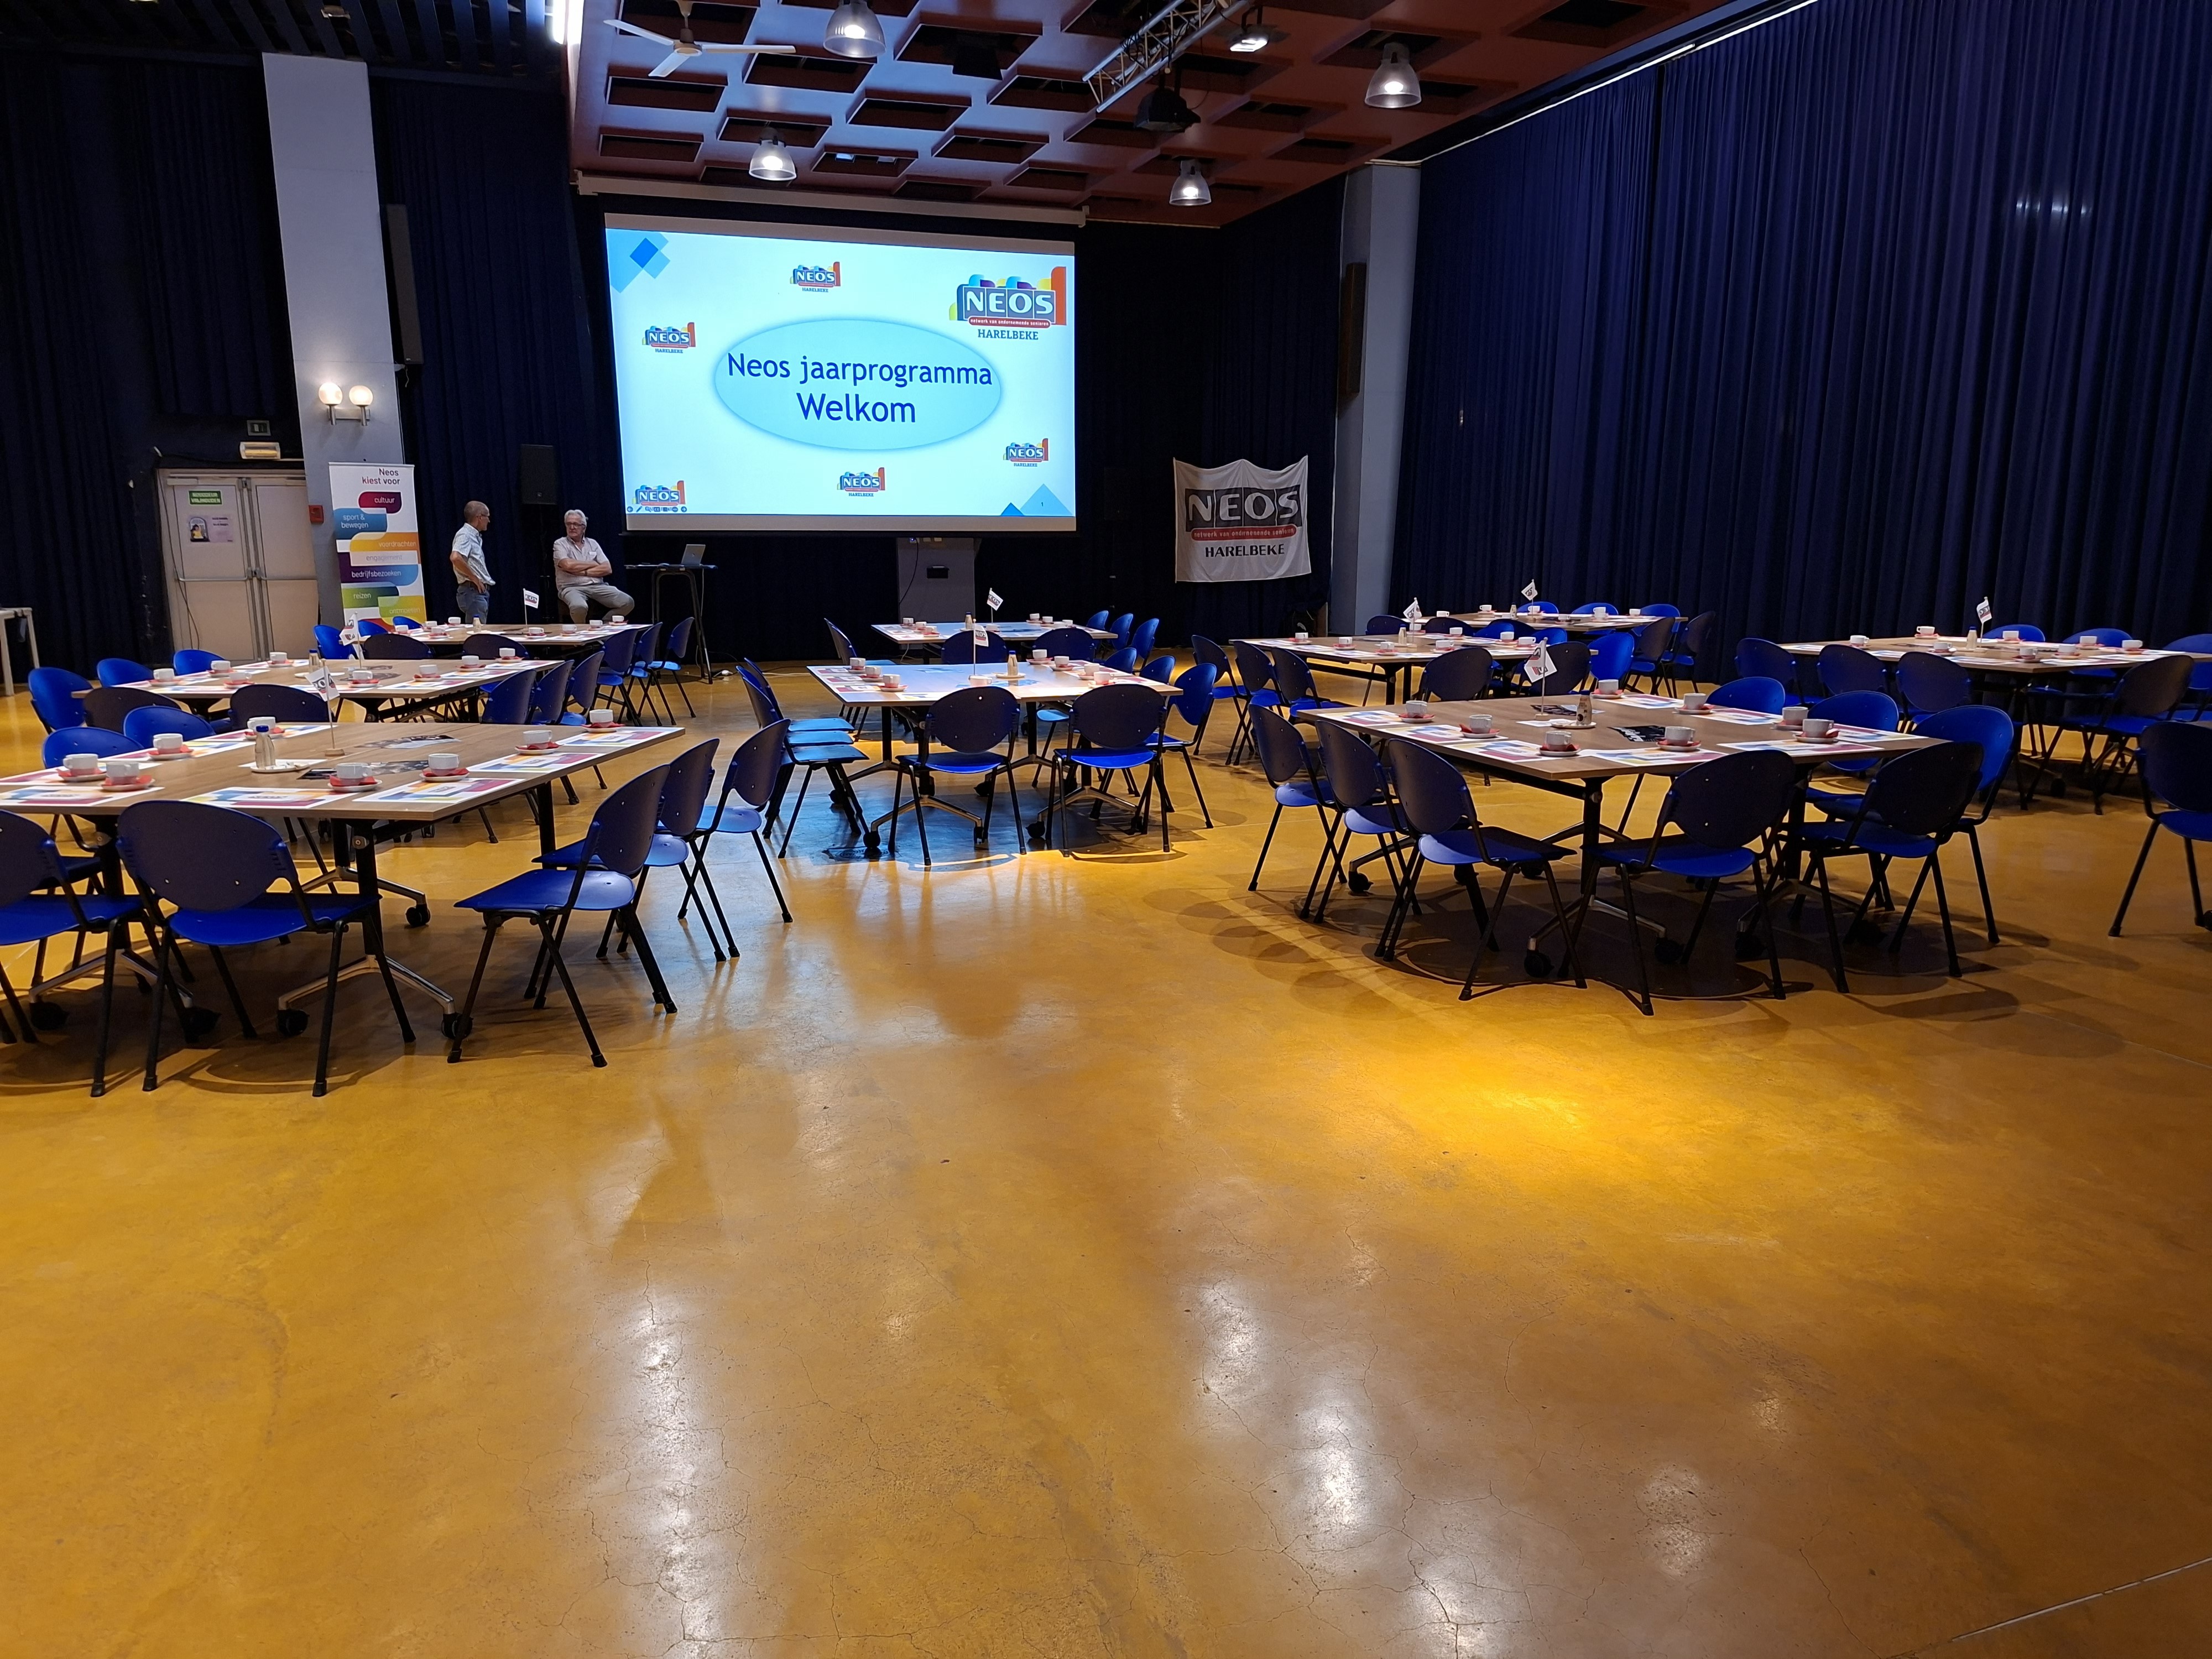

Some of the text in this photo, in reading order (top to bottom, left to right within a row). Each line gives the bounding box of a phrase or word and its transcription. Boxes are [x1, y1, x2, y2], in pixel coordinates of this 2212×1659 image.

[797, 271, 834, 282] NEOS
[966, 291, 1053, 314] NEOS
[649, 332, 690, 343] NEOS
[977, 328, 1039, 340] HARELBEKE
[727, 352, 993, 388] Neos jaarprogramma
[796, 392, 916, 423] Welkom
[1009, 448, 1044, 457] NEOS
[379, 468, 399, 476] Neos
[362, 476, 381, 484] kiest
[843, 478, 880, 487] NEOS
[639, 491, 679, 500] NEOS
[1188, 491, 1298, 521] NEOS
[1205, 544, 1285, 558] HARELBEKE
[351, 570, 401, 578] bedrijfsbezoeken
